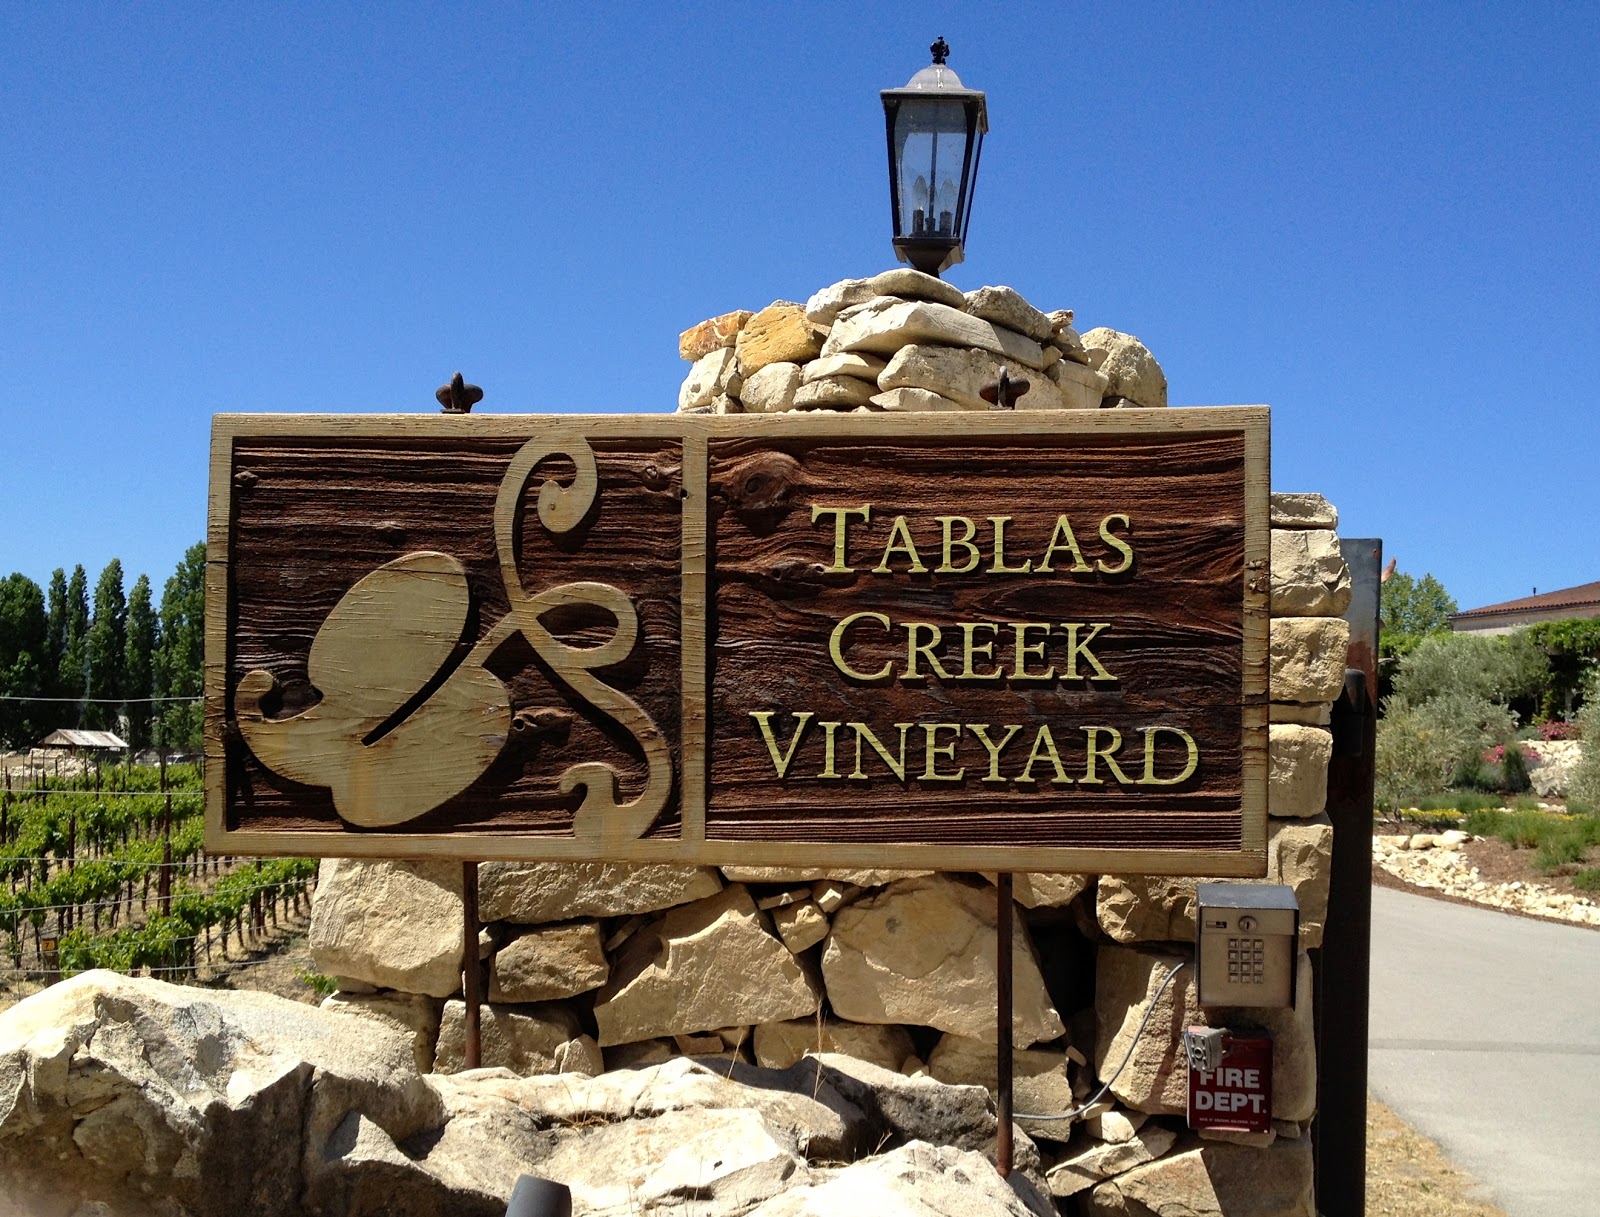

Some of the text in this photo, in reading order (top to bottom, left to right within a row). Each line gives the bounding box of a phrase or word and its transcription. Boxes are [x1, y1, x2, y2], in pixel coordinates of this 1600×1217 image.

[811, 503, 1135, 575] TABLAS
[828, 611, 1118, 682] CREEK
[748, 711, 1199, 786] VINEYARD
[1195, 1090, 1267, 1114] DEPT.
[1199, 1067, 1260, 1089] FIRE
